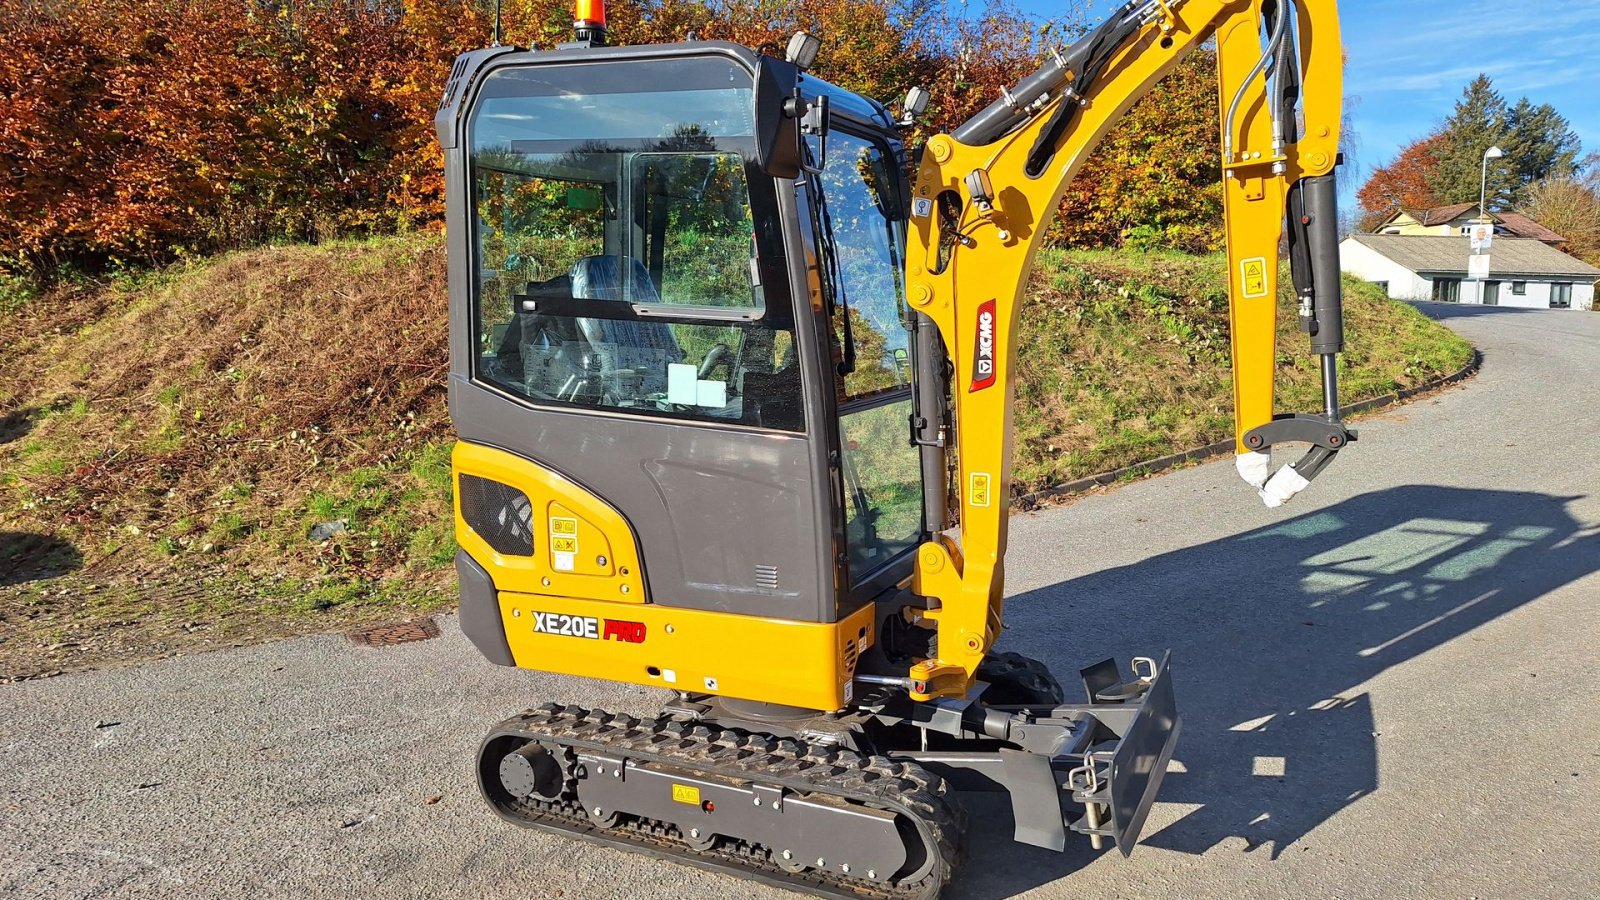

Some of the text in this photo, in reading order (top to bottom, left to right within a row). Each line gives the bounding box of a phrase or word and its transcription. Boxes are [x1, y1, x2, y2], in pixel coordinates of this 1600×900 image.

[979, 311, 993, 360] XCMG
[532, 611, 647, 644] XE20E PRO
